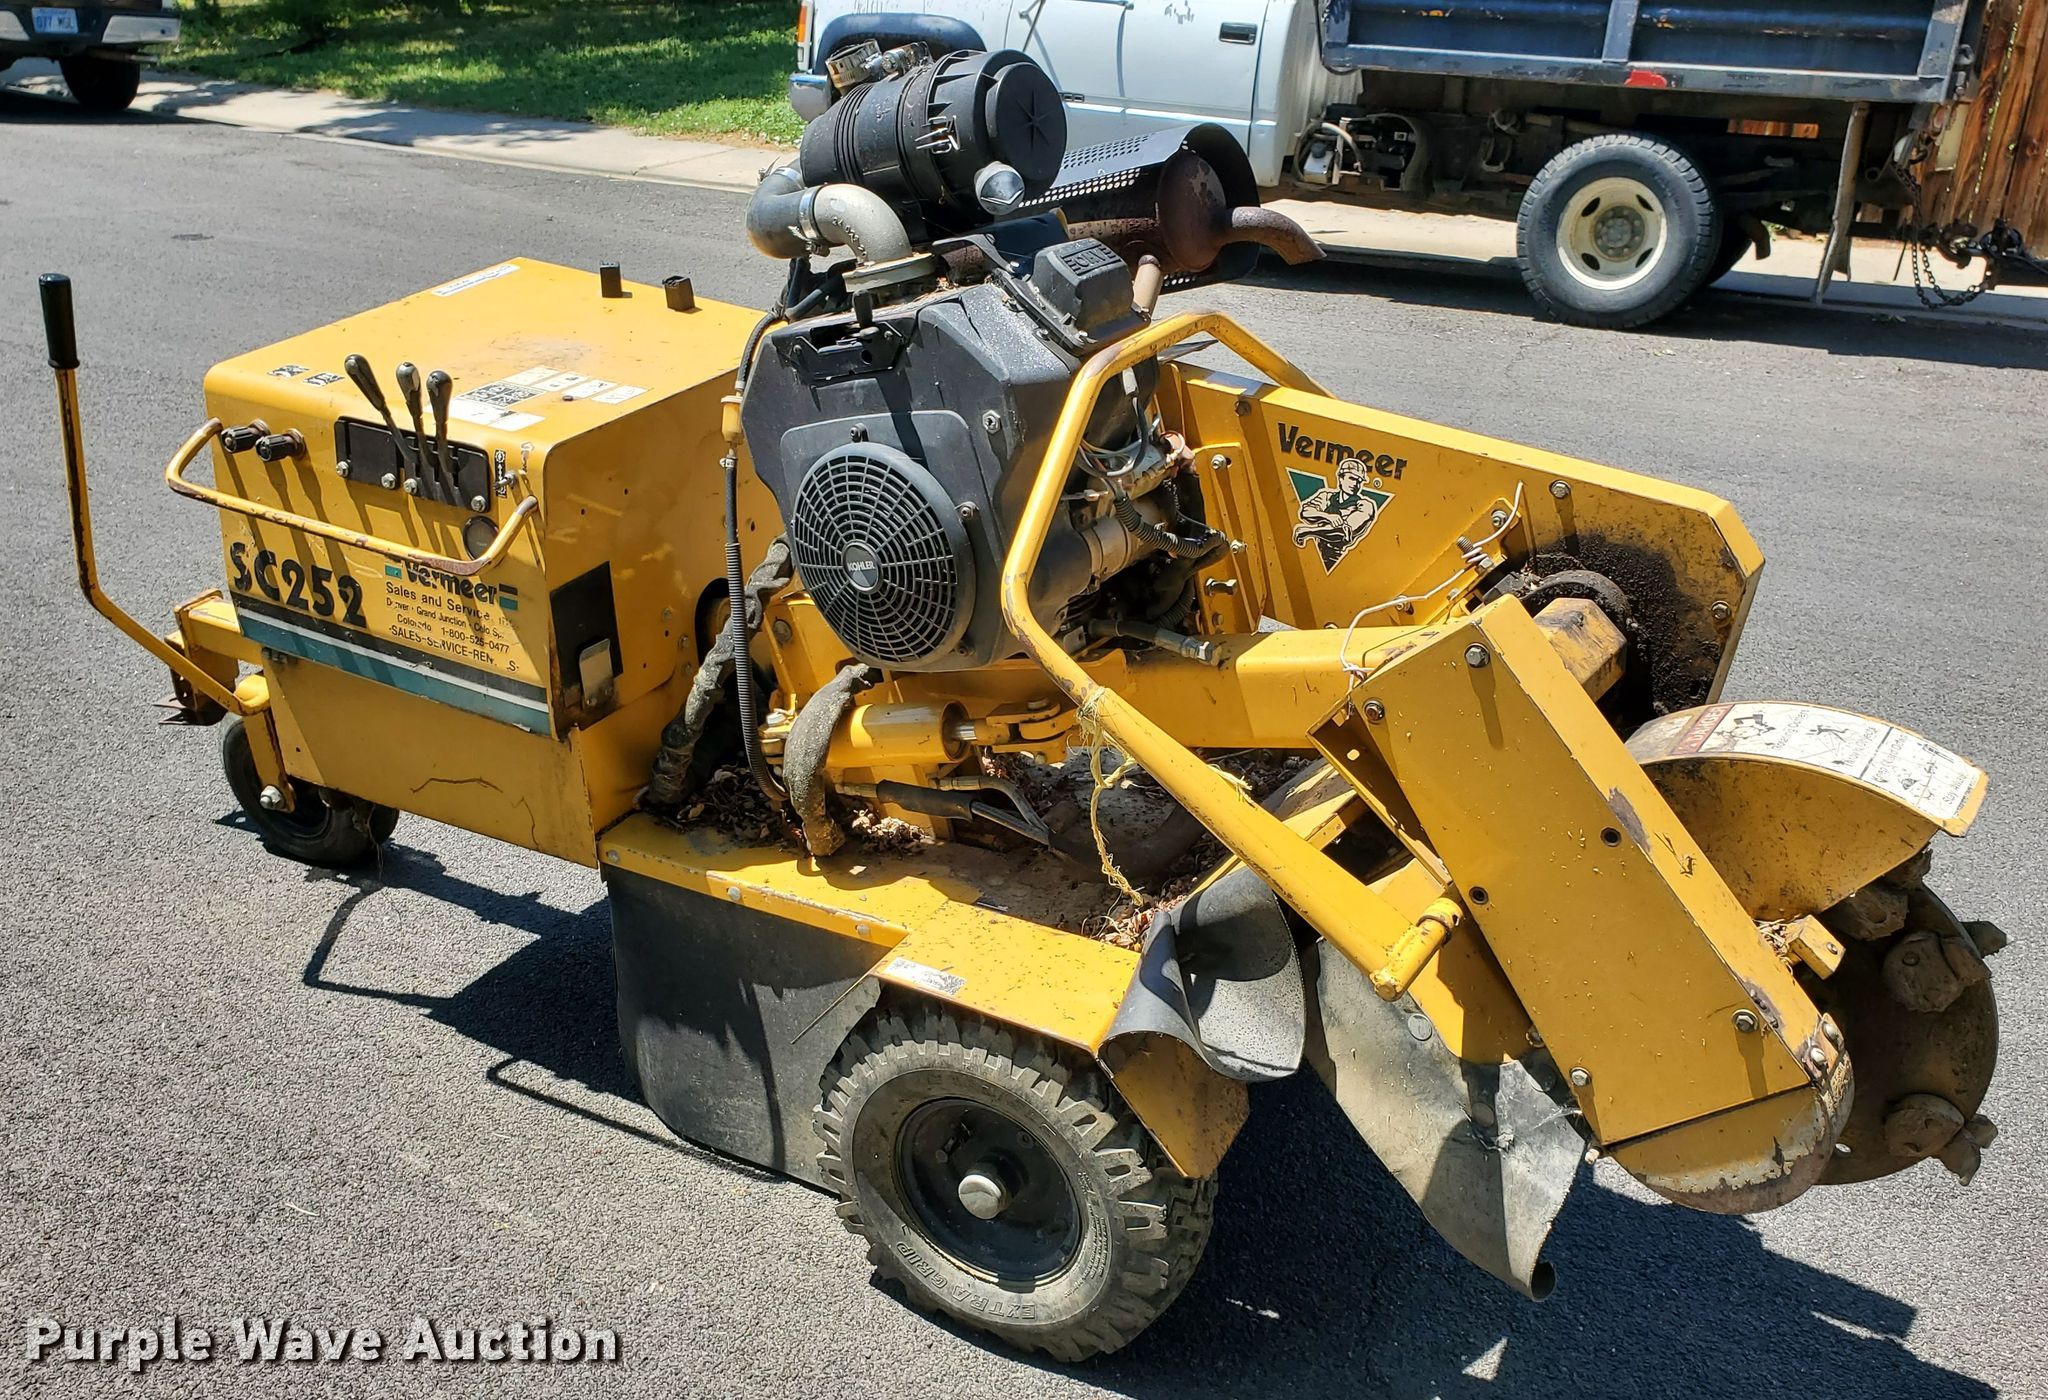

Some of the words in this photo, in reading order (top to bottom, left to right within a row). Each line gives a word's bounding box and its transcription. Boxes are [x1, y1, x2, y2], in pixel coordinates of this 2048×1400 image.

[1278, 422, 1408, 480] Vermeer
[847, 560, 876, 572] KOHLER
[230, 542, 367, 628] SC252
[385, 581, 417, 601] Sales
[421, 593, 443, 608] and
[416, 605, 437, 621] Grand
[896, 1241, 949, 1290] GRIP
[952, 1285, 1037, 1321] EXTRA
